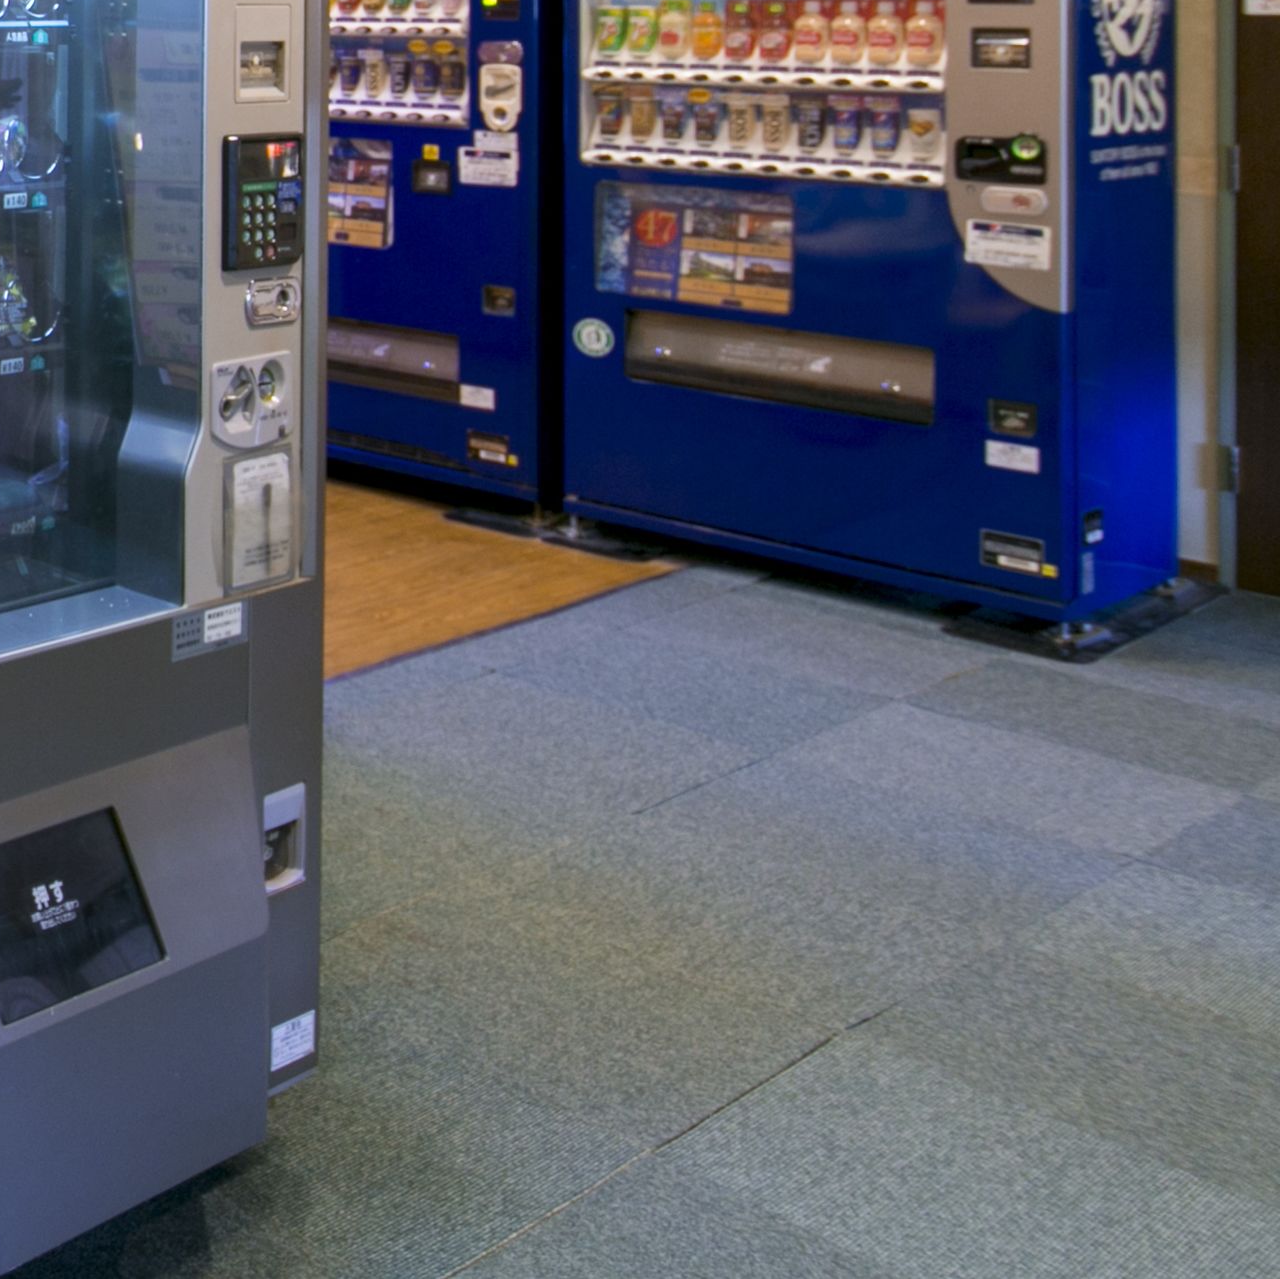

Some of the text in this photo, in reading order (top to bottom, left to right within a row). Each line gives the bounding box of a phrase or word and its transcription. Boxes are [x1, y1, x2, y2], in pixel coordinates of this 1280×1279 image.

[1090, 70, 1167, 136] BOSS
[5, 194, 26, 206] ¥140
[638, 211, 677, 241] 47
[1, 360, 24, 373] ¥140
[32, 880, 64, 910] 押す
